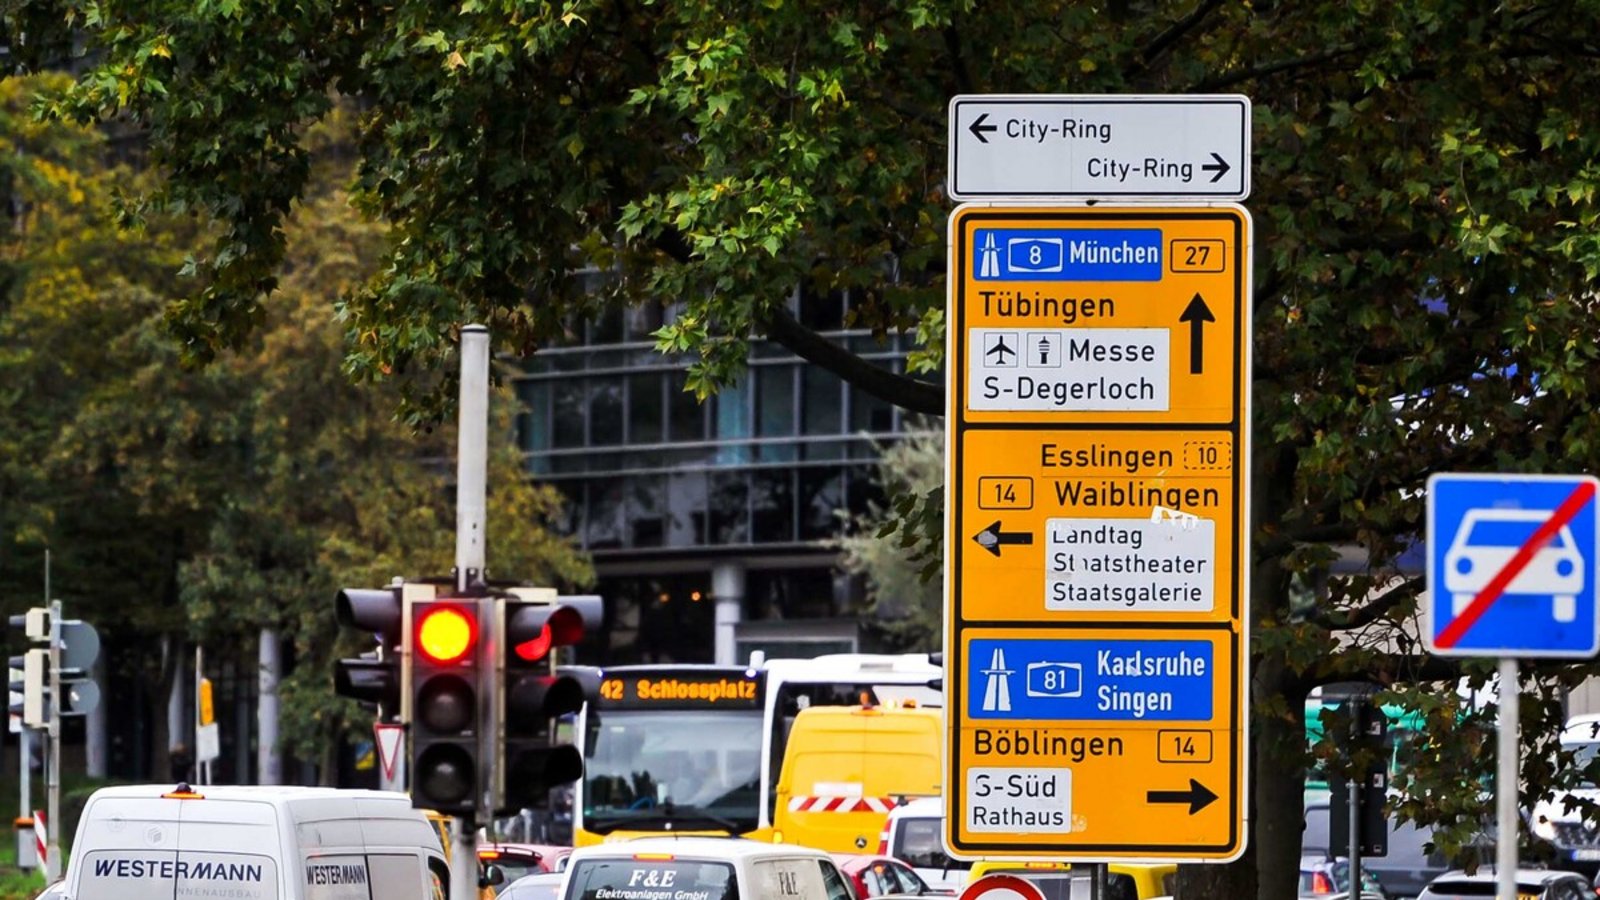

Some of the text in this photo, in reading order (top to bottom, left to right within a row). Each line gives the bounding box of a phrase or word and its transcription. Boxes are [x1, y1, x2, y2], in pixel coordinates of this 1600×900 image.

[1006, 119, 1112, 143] City-Ring
[1087, 158, 1193, 183] City-Ring
[1029, 240, 1159, 265] 8 München
[1184, 246, 1210, 266] 27
[979, 291, 1115, 324] Tübingen
[1069, 339, 1155, 362] Messe
[983, 376, 1154, 405] S-Degerloch
[1041, 444, 1173, 473] Esslingen
[1198, 447, 1217, 465] 10
[995, 484, 1016, 503] 14
[1055, 481, 1219, 511] Waiblingen
[1053, 524, 1142, 550] Landtag
[1053, 582, 1202, 606] Staatsgalerie
[1097, 650, 1205, 676] Karlsruhe
[637, 679, 756, 702] Schlossplatz
[1044, 670, 1065, 690] 81
[1097, 685, 1172, 718] Singen
[974, 729, 1124, 763] Böblingen
[1174, 737, 1195, 756] 14
[975, 774, 1056, 797] S-Süd
[973, 806, 1064, 826] Rathaus
[95, 859, 262, 882] WESTERMANN
[306, 864, 366, 885] WESTERMANN
[628, 869, 677, 888] F&E
[595, 888, 710, 900] Elektroanlagen GmbH
